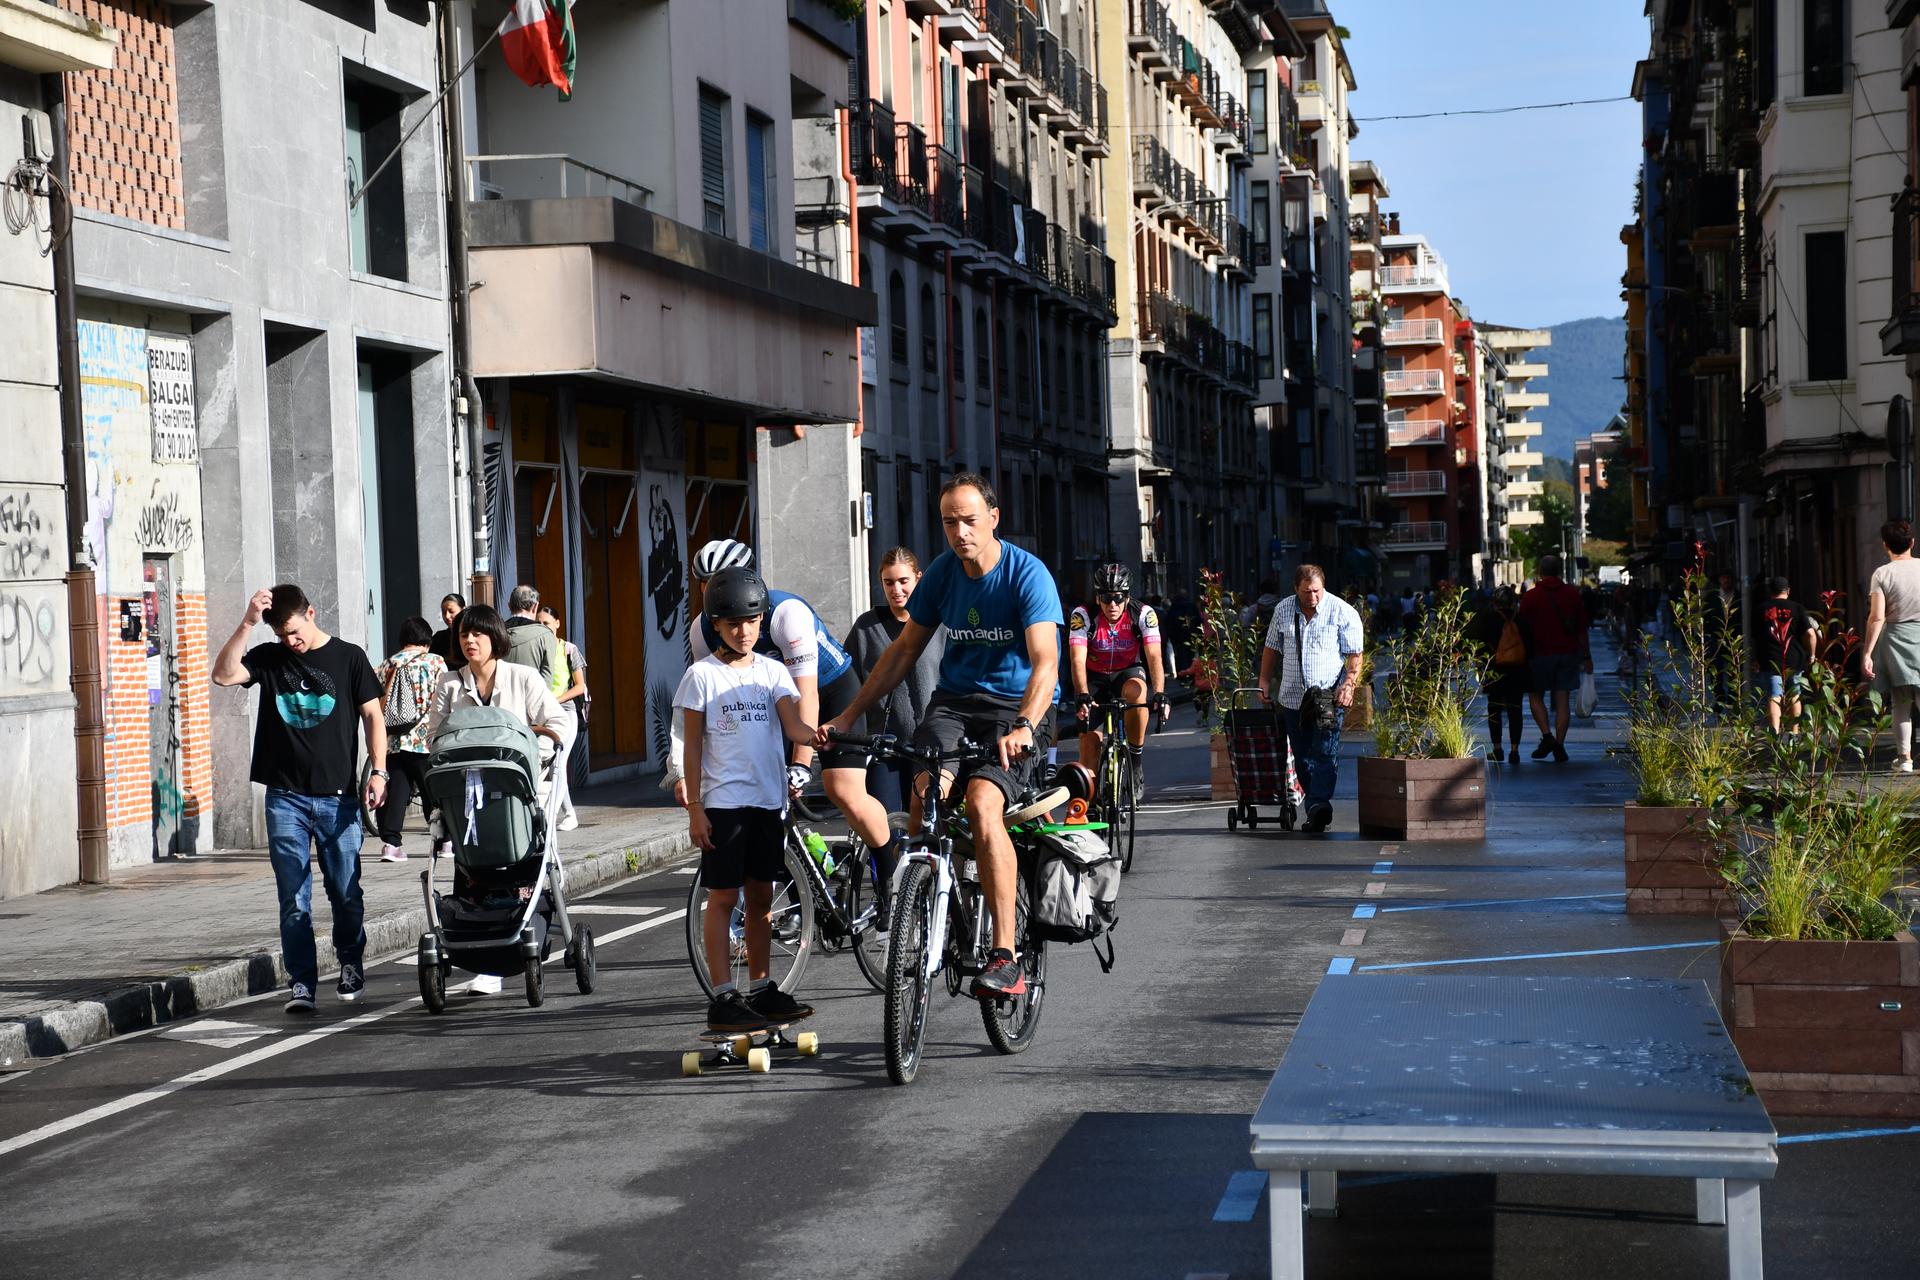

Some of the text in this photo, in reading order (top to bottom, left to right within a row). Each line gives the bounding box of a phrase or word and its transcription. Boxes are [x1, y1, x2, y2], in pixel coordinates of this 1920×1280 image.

[149, 348, 190, 372] BERAZUBI
[151, 380, 193, 406] SALGAI
[368, 588, 375, 615] A
[740, 712, 752, 722] al
